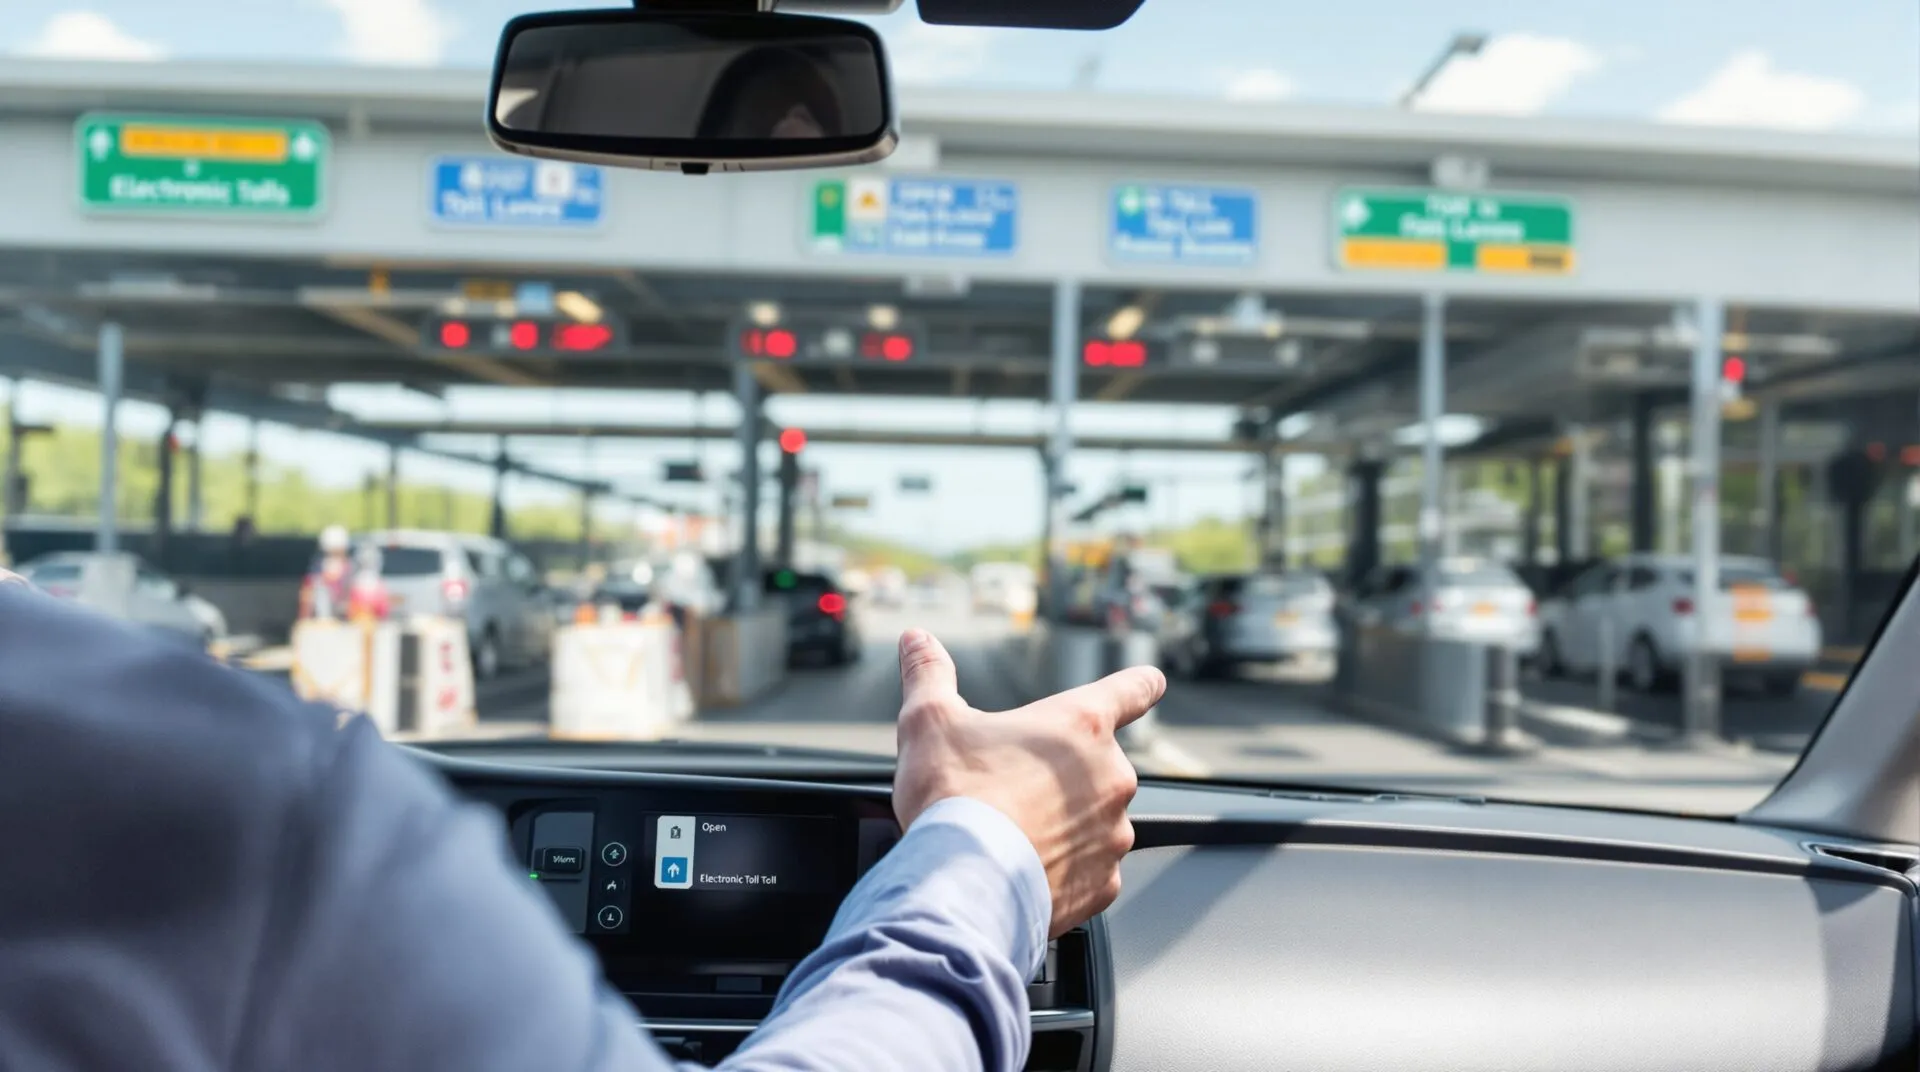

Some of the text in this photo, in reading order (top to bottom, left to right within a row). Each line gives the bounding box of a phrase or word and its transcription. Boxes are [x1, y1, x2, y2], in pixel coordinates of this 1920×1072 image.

[702, 822, 727, 834] Open
[700, 873, 777, 885] Electronic Toll Toll
